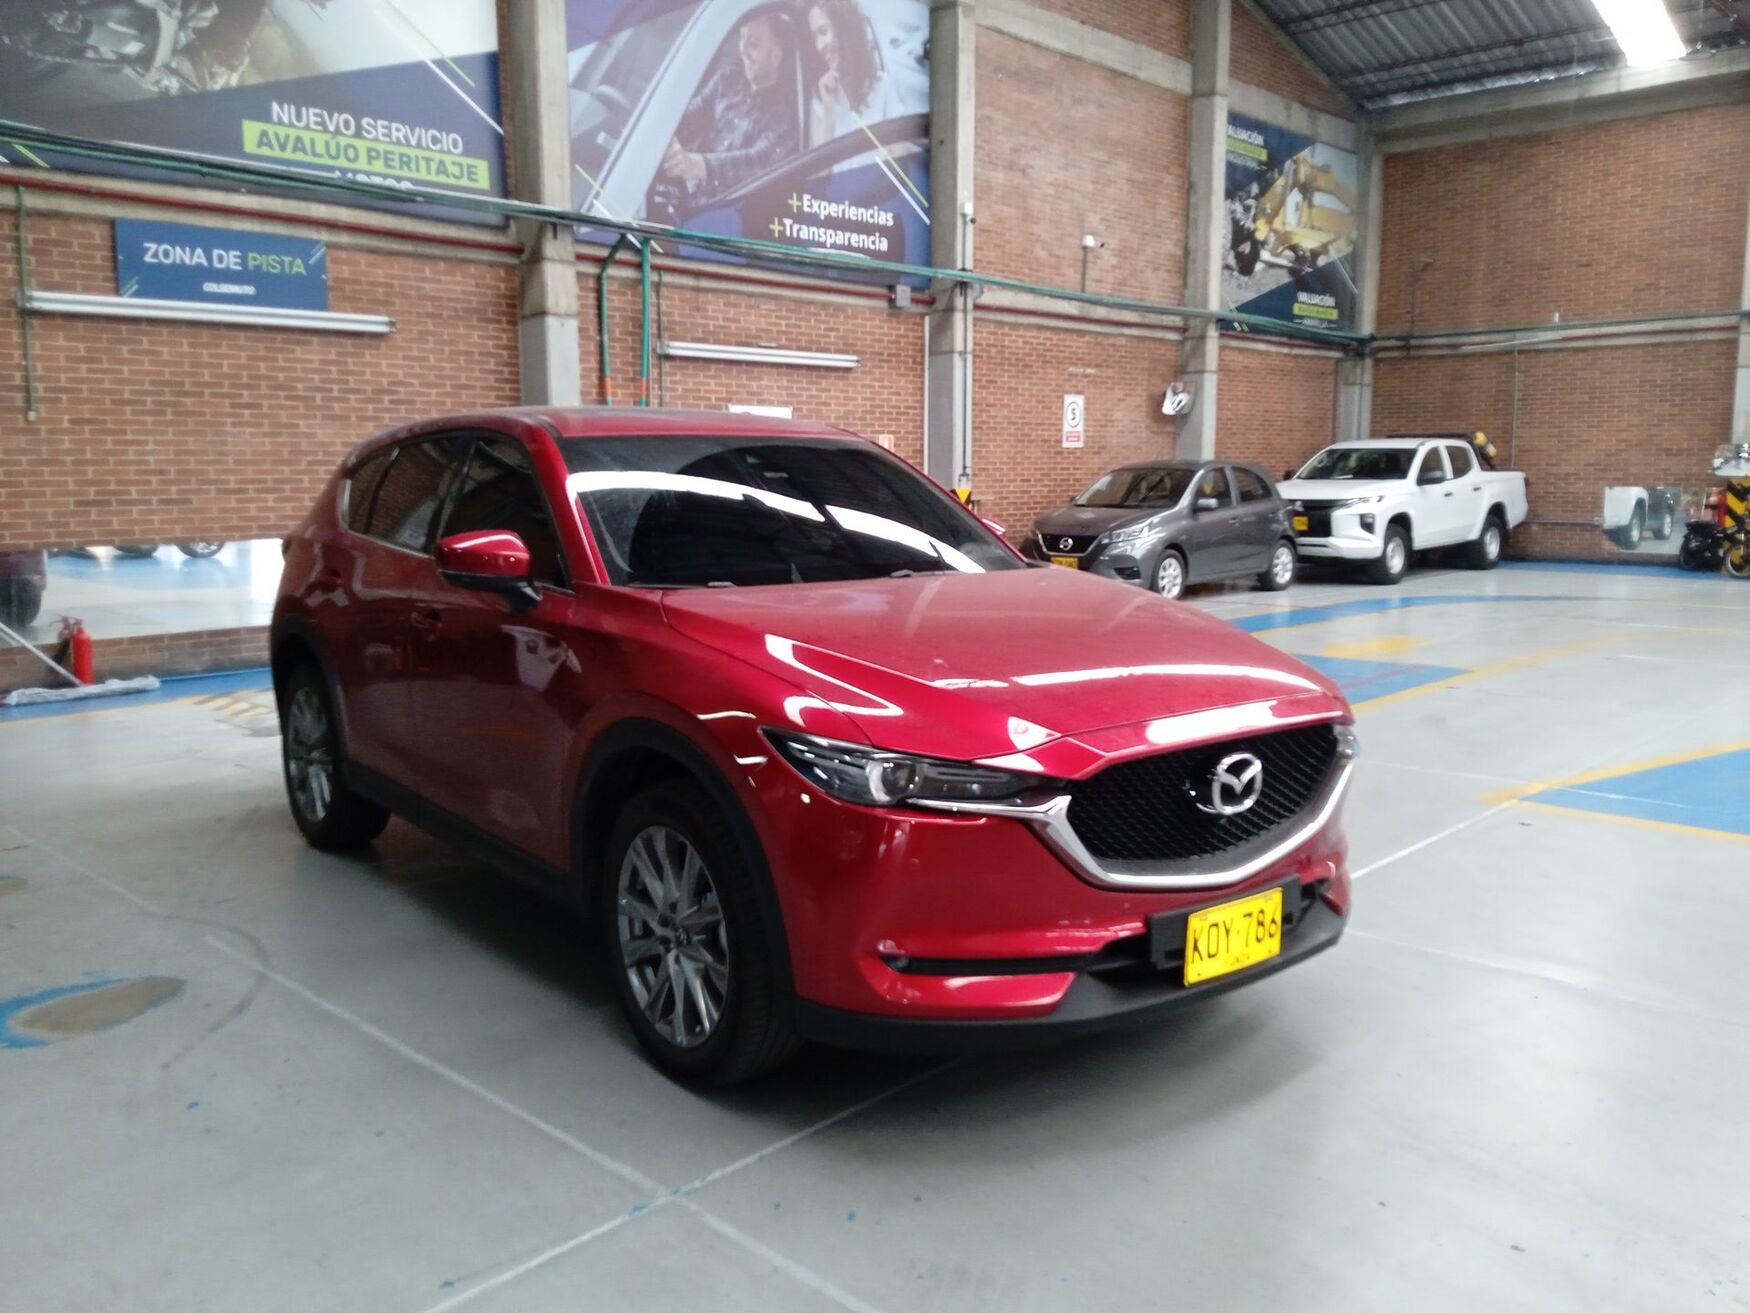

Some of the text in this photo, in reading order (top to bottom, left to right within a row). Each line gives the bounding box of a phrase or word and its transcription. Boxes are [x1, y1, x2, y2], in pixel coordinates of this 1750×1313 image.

[271, 101, 463, 154] NUEVO SERVICIO
[256, 129, 360, 164] AVALÚO
[366, 146, 480, 183] PERITAJE
[143, 242, 307, 275] ZONA DE PISTA
